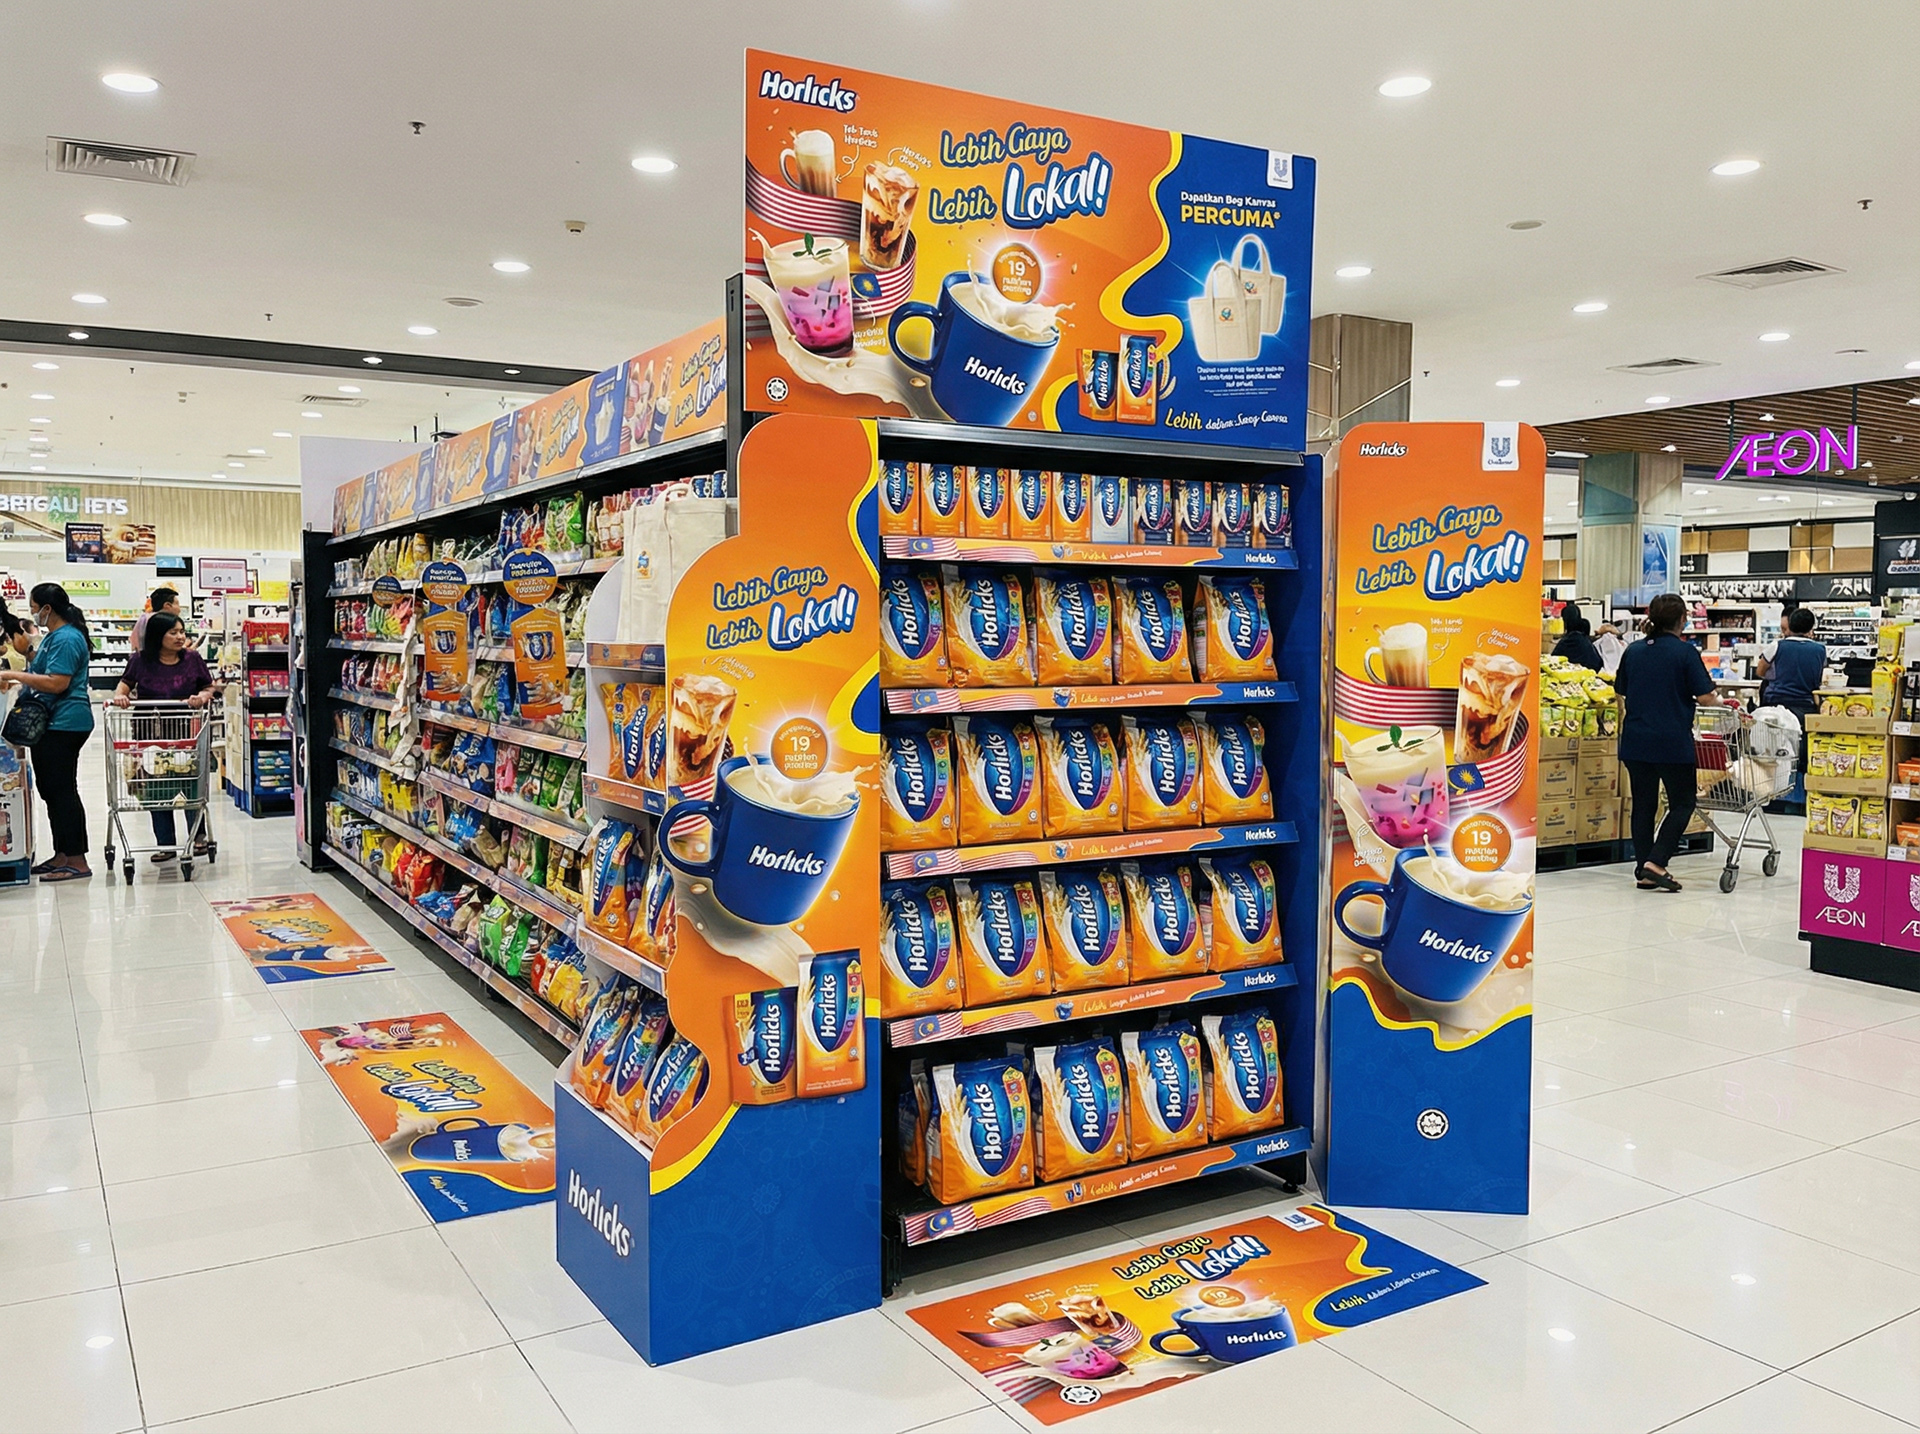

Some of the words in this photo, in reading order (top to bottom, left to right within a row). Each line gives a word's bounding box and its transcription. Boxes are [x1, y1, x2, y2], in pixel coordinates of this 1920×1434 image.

[760, 70, 857, 112] Horlicks
[942, 129, 1004, 166] Lebih
[1007, 124, 1069, 163] Gaya
[930, 187, 995, 222] Lebih
[1008, 158, 1110, 224] Lokal!
[1181, 192, 1224, 206] Dapatkan
[1245, 196, 1276, 208] Kanvas
[1008, 260, 1025, 277] 19
[964, 356, 1026, 396] Horlicks
[1164, 408, 1202, 430] Lebih
[1360, 442, 1407, 457] Horlicks
[1375, 517, 1435, 552] Lebih
[1439, 506, 1501, 536] Gaya
[715, 582, 770, 609] Lebih
[774, 567, 826, 595] Gaya
[1358, 562, 1414, 593] Lebih
[1427, 534, 1526, 595] Lokal!
[708, 619, 761, 647] Lebih
[770, 587, 856, 645] Lokal!
[892, 579, 919, 646] Horlicks
[973, 579, 999, 647] Horlicks
[1140, 589, 1166, 649] Horlicks
[1229, 591, 1251, 648] Horlicks
[790, 736, 811, 752] 19
[897, 738, 926, 806] Horlicks
[986, 734, 1012, 801] Horlicks
[1069, 730, 1093, 796] Horlicks
[1154, 728, 1175, 793] Horlicks
[1224, 726, 1247, 786] Horlicks
[748, 845, 825, 876] Horlicks
[1471, 830, 1492, 846] 19
[987, 890, 1016, 962] Horlicks
[1073, 885, 1099, 952] Horlicks
[1152, 876, 1180, 942] Horlicks
[1230, 872, 1259, 931] Horlicks
[899, 899, 929, 972] Horlicks
[1419, 929, 1493, 964] Horlicks
[818, 974, 837, 1037] Horlicks
[762, 1004, 781, 1072] Horlicks
[1232, 1032, 1261, 1099] Horlicks
[1070, 1064, 1100, 1138] Horlicks
[1156, 1048, 1183, 1118] Horlicks
[973, 1083, 1003, 1160] Horlicks
[568, 1168, 631, 1256] Horlicks
[1114, 1254, 1168, 1279] Lebih
[1135, 1274, 1189, 1299] Lebih
[1177, 1235, 1268, 1280] Lokal!
[1227, 1329, 1287, 1345] Horlicks
